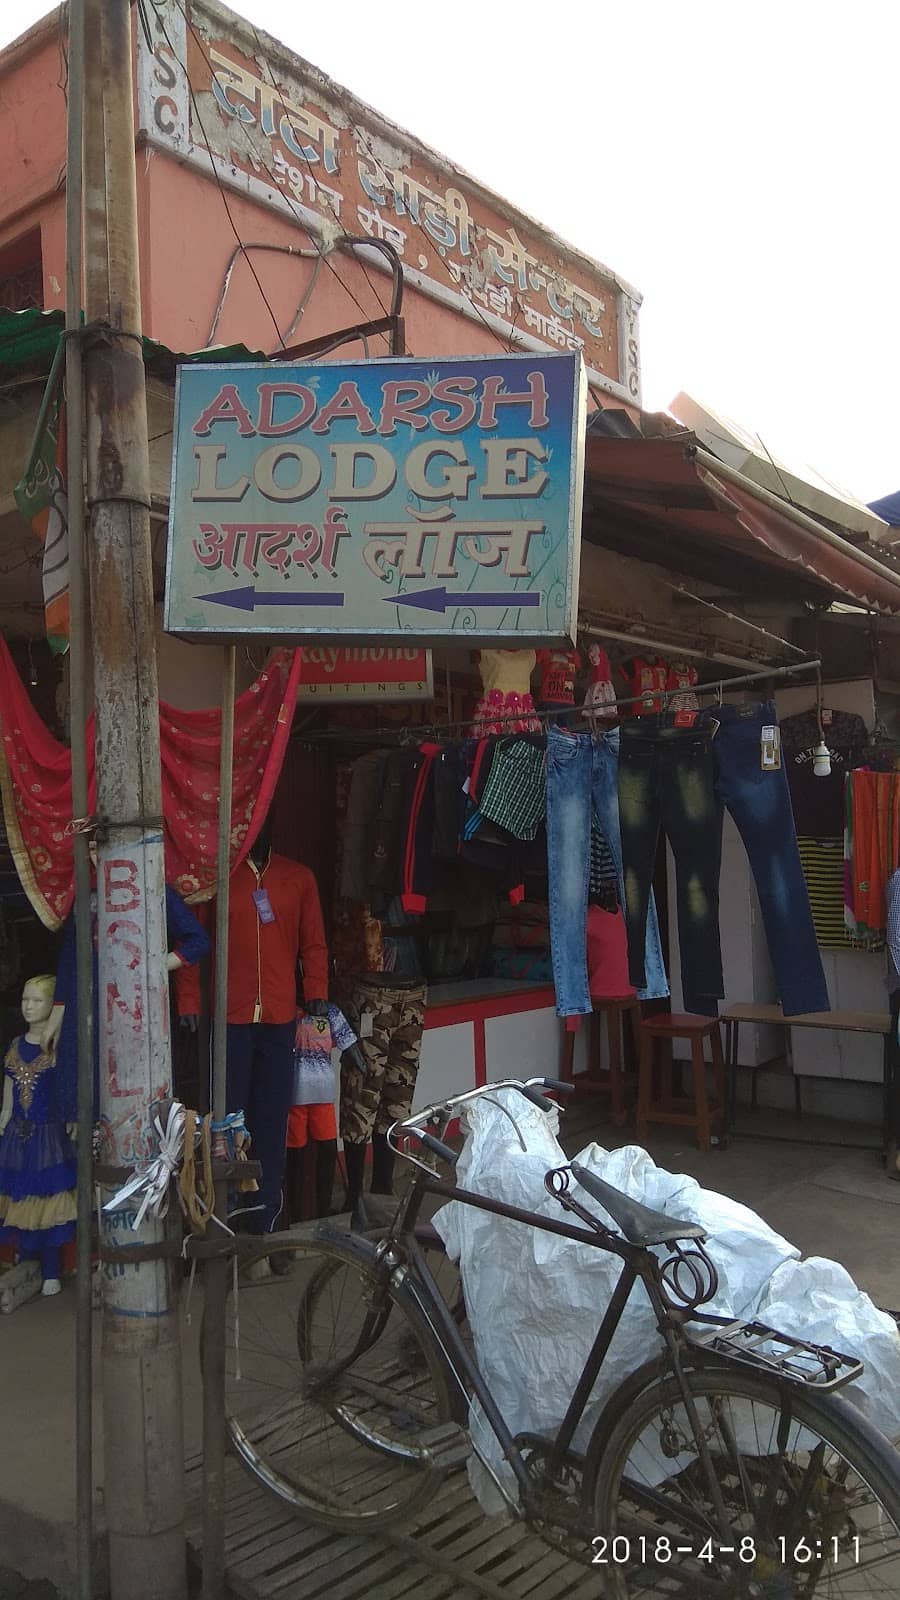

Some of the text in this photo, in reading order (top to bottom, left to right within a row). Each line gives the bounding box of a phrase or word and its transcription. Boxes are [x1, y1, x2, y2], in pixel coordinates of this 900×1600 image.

[209, 47, 340, 174] टाटा
[192, 371, 550, 437] ADARSH
[191, 438, 550, 502] LODGE
[192, 504, 545, 579] आदर्श लॉज
[103, 859, 143, 1099] BSNL
